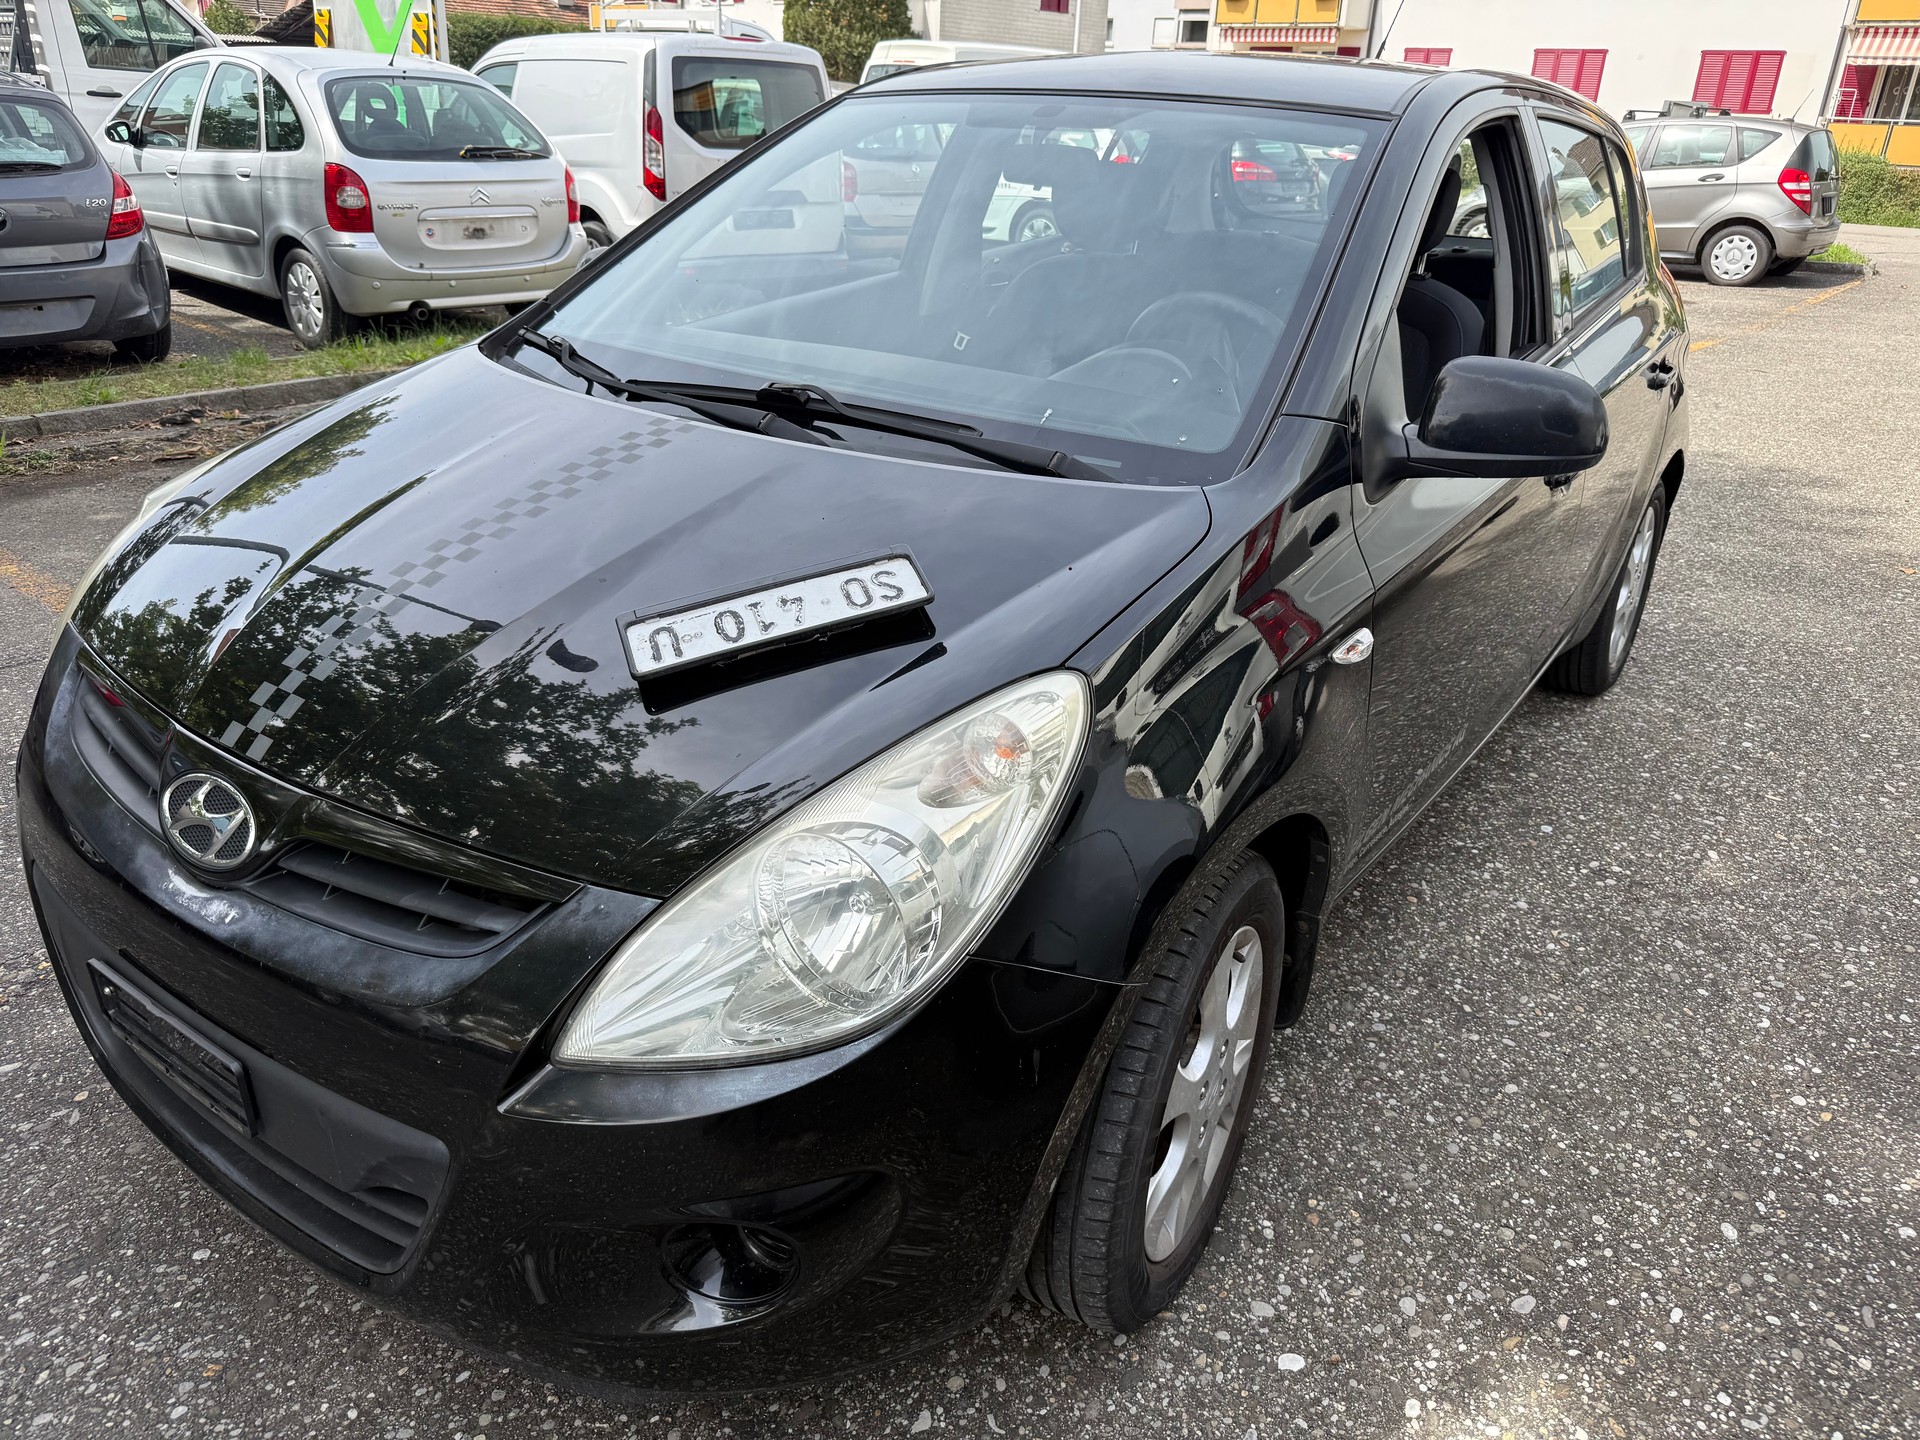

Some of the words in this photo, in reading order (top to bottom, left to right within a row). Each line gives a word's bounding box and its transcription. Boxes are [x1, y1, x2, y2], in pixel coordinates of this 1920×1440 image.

[841, 570, 905, 609] SO
[713, 594, 805, 644] 410
[649, 625, 684, 663] U
